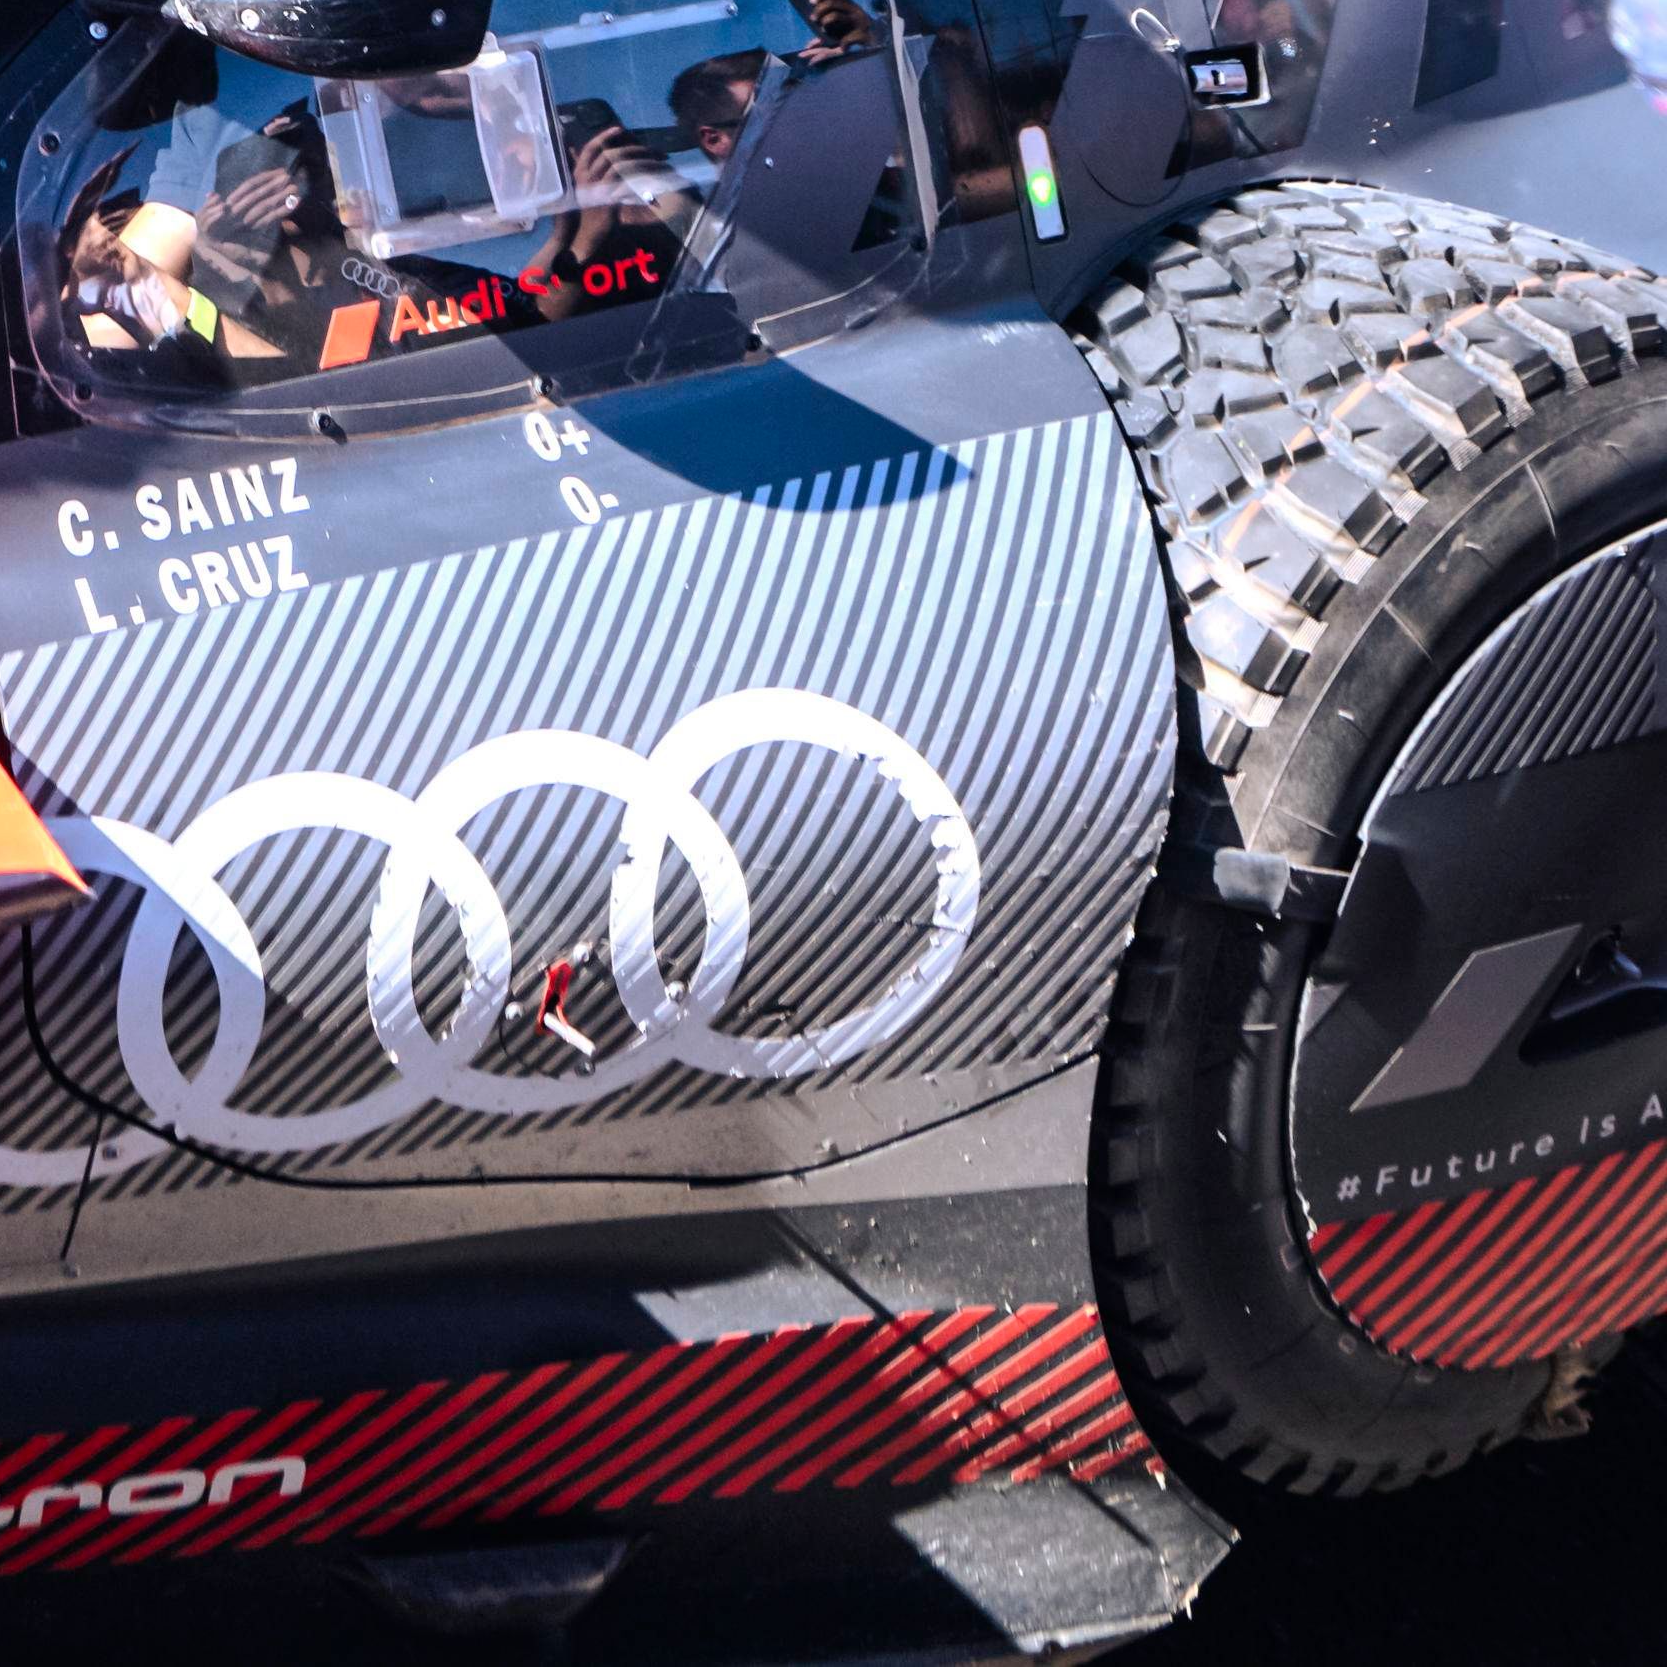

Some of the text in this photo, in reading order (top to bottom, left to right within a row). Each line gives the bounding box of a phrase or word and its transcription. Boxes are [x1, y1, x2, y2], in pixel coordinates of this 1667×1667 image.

[388, 247, 660, 344] Audi Sort
[57, 498, 120, 557] C.
[135, 457, 311, 541] SAINZ
[74, 577, 146, 634] L.
[158, 535, 310, 615] CRUZ
[1336, 1133, 1556, 1202] #Future
[1579, 1114, 1617, 1145] Is
